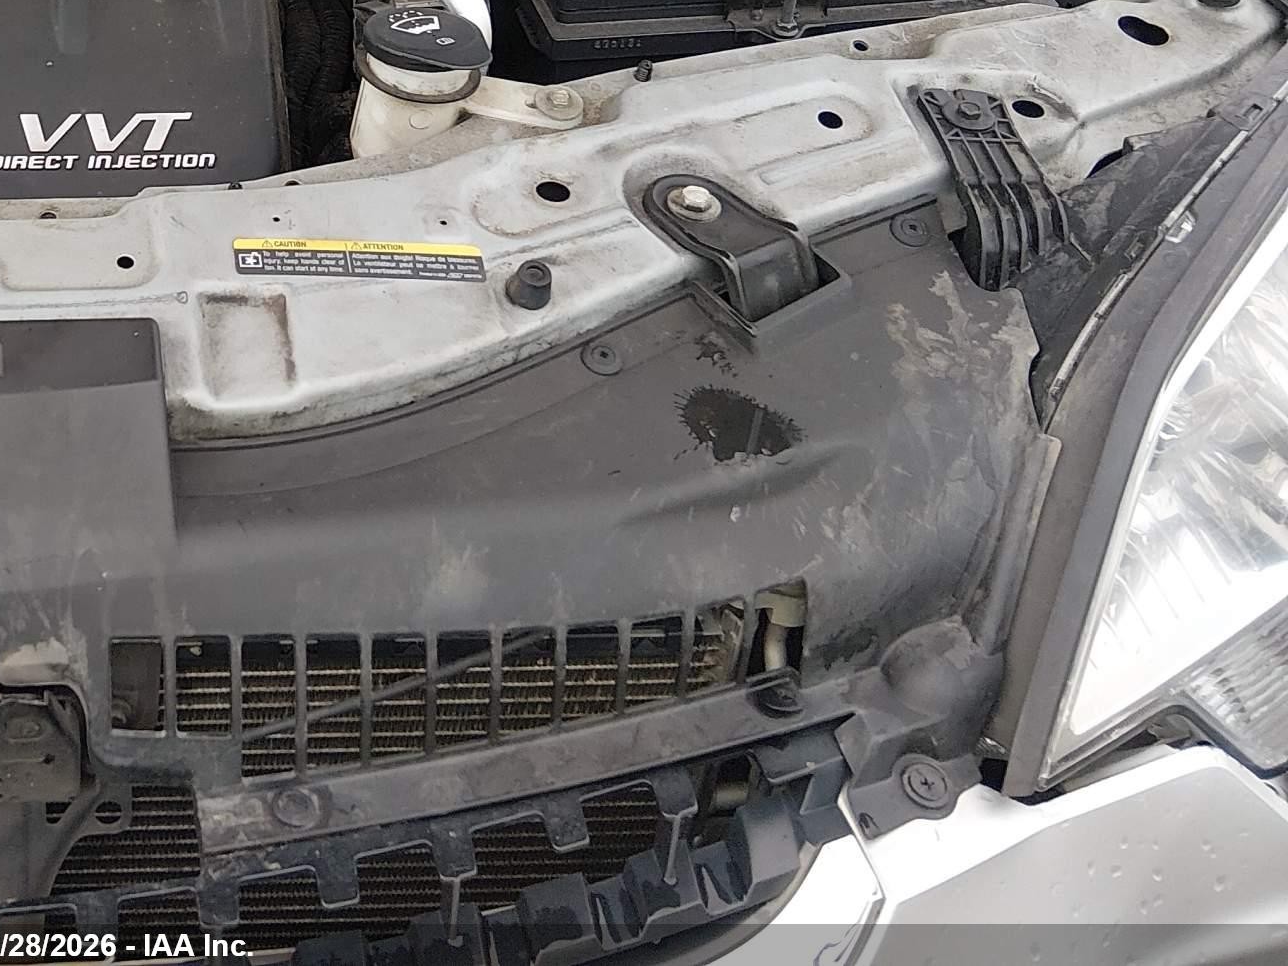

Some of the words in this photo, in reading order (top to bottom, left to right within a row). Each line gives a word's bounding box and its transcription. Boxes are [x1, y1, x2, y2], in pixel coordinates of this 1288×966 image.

[20, 112, 193, 153] VVT
[87, 153, 216, 170] INJECTION
[274, 240, 307, 248] CAUTION
[363, 242, 404, 251] ATTENTION
